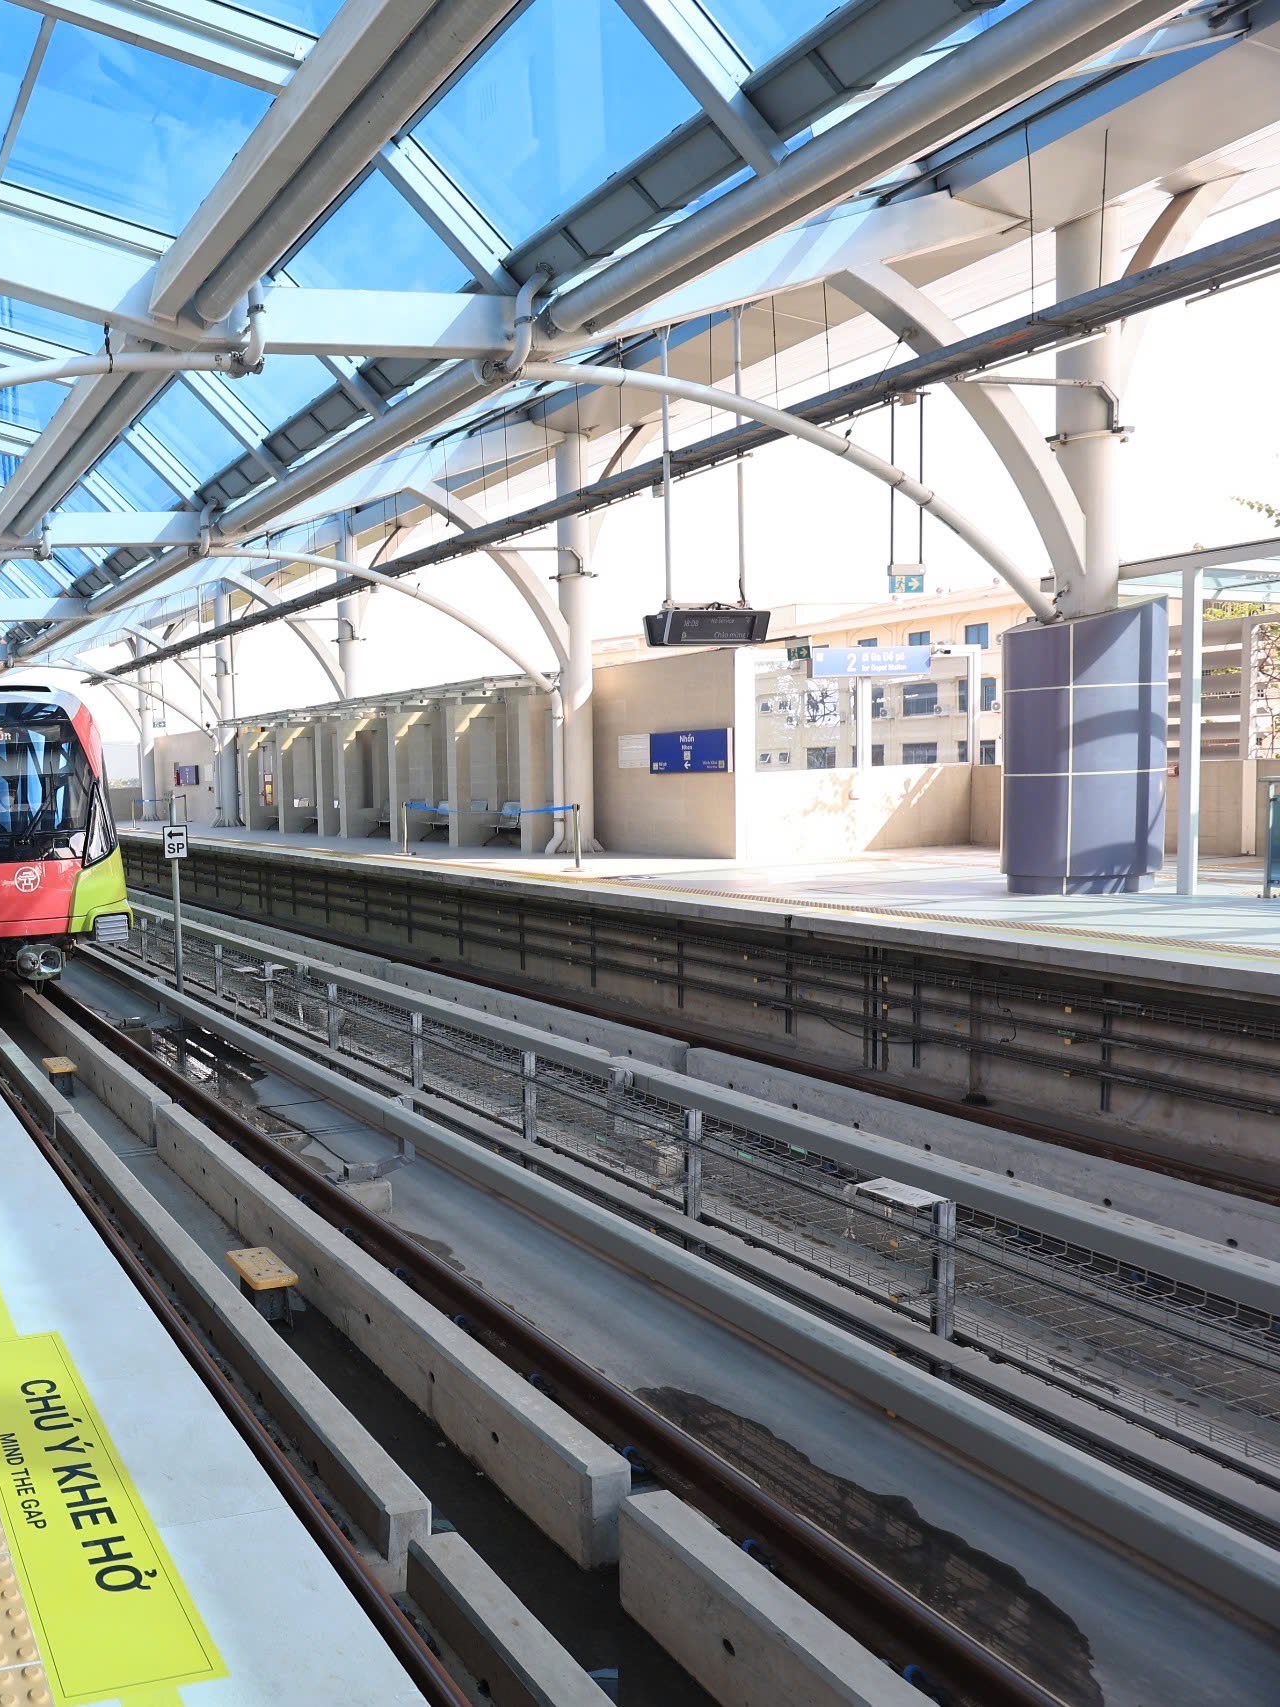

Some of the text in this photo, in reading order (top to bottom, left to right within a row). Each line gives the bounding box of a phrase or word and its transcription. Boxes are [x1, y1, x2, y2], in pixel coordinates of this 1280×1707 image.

[846, 652, 857, 673] 2
[167, 842, 185, 854] SP
[10, 1467, 36, 1497] THE
[20, 1378, 158, 1593] CHÚ Ý KHE HỞ
[21, 1498, 48, 1530] GAP
